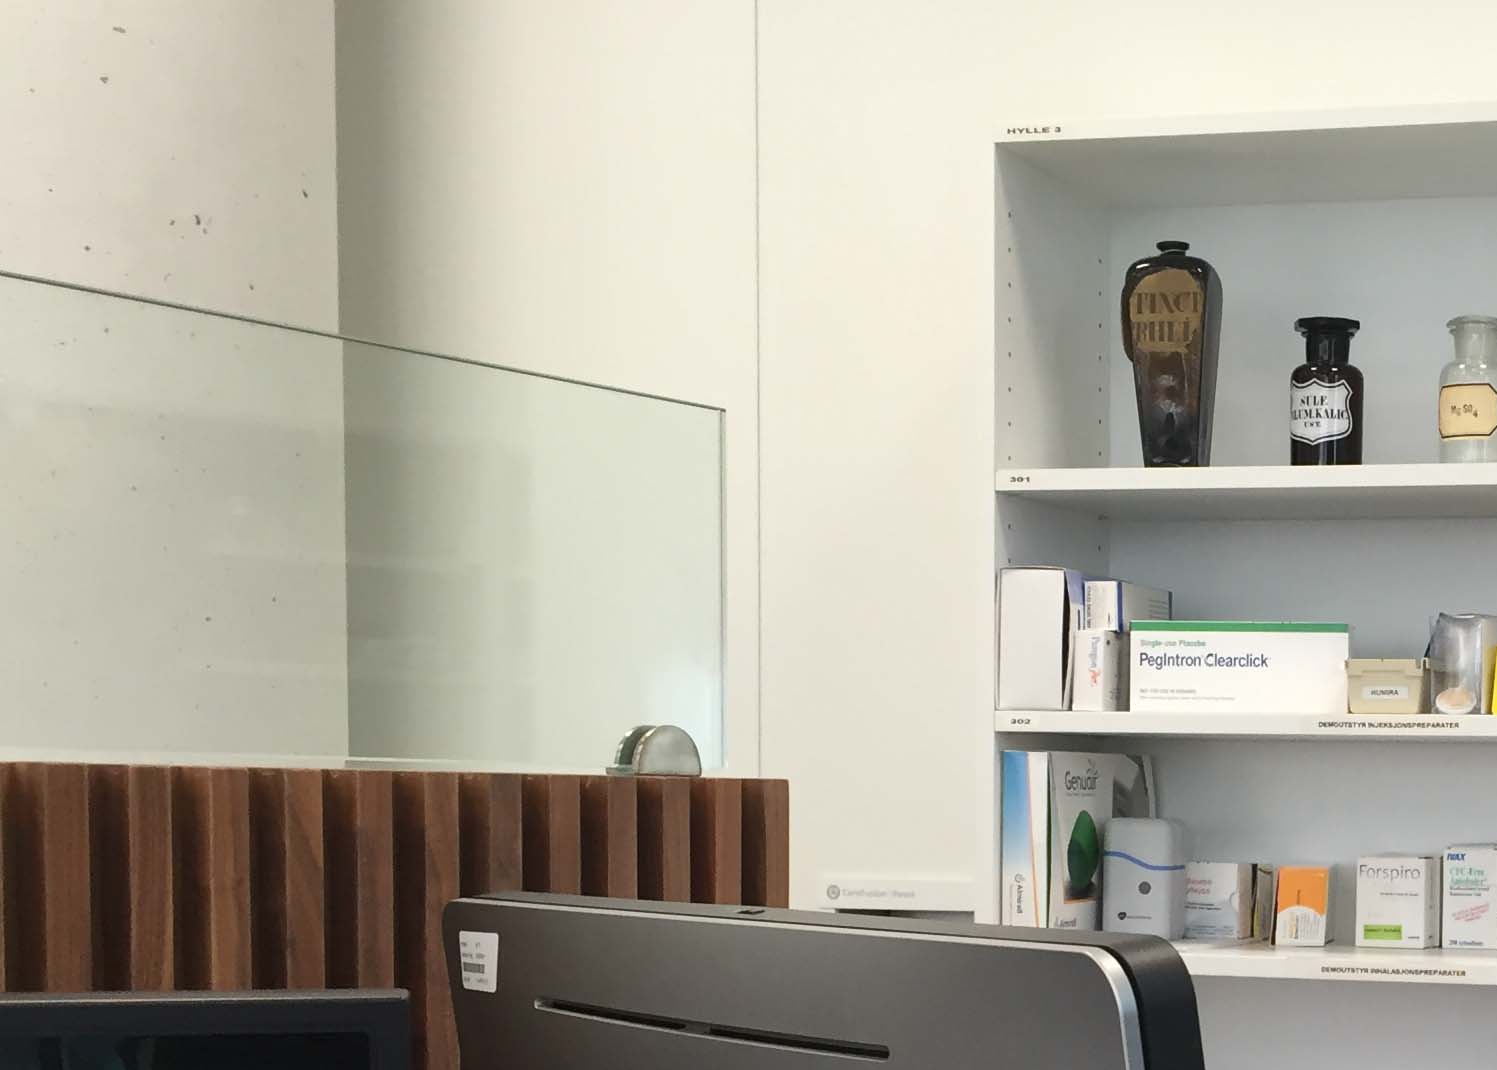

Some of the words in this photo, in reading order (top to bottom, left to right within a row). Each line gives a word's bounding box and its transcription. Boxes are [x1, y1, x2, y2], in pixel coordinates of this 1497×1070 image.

[1007, 126, 1050, 134] HYLLE
[1139, 652, 1201, 670] PegIntron
[1203, 653, 1269, 668] Clearclick
[1359, 863, 1421, 881] Forspiro
